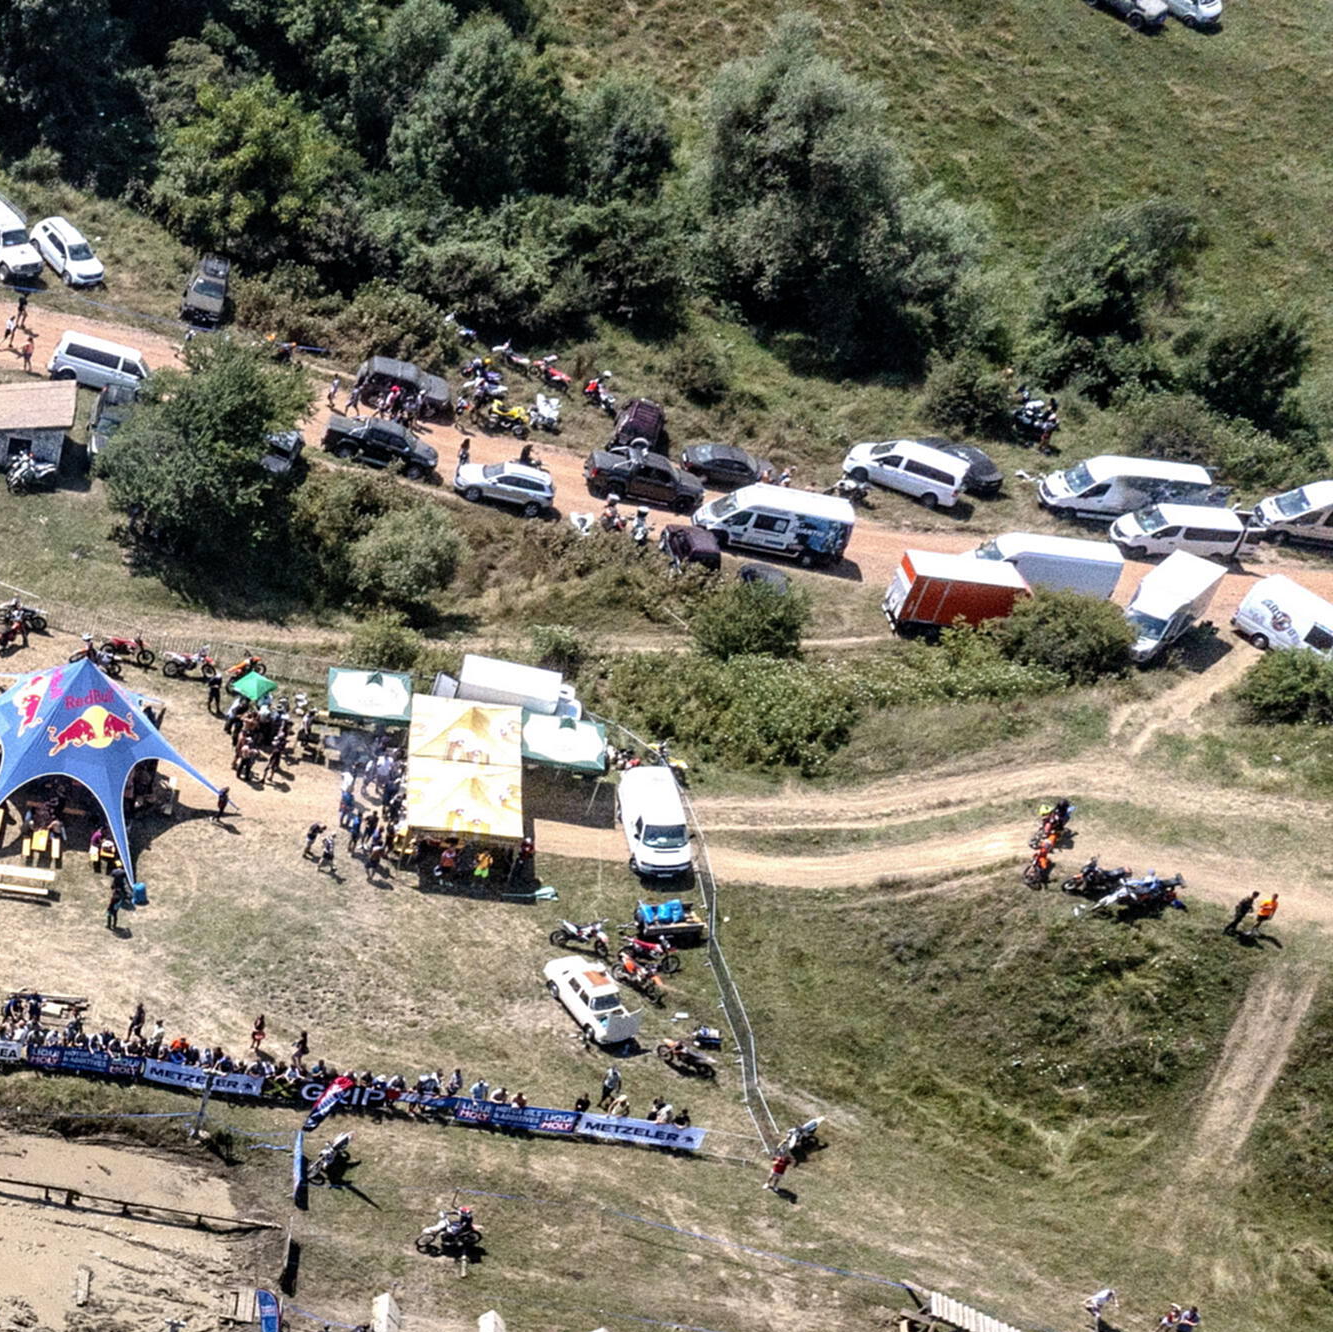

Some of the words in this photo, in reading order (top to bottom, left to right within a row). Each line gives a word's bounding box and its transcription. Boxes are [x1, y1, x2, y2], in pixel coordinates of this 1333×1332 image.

[150, 1066, 239, 1089] METZEER
[541, 1121, 572, 1131] MOLY
[584, 1121, 679, 1142] METZELER
